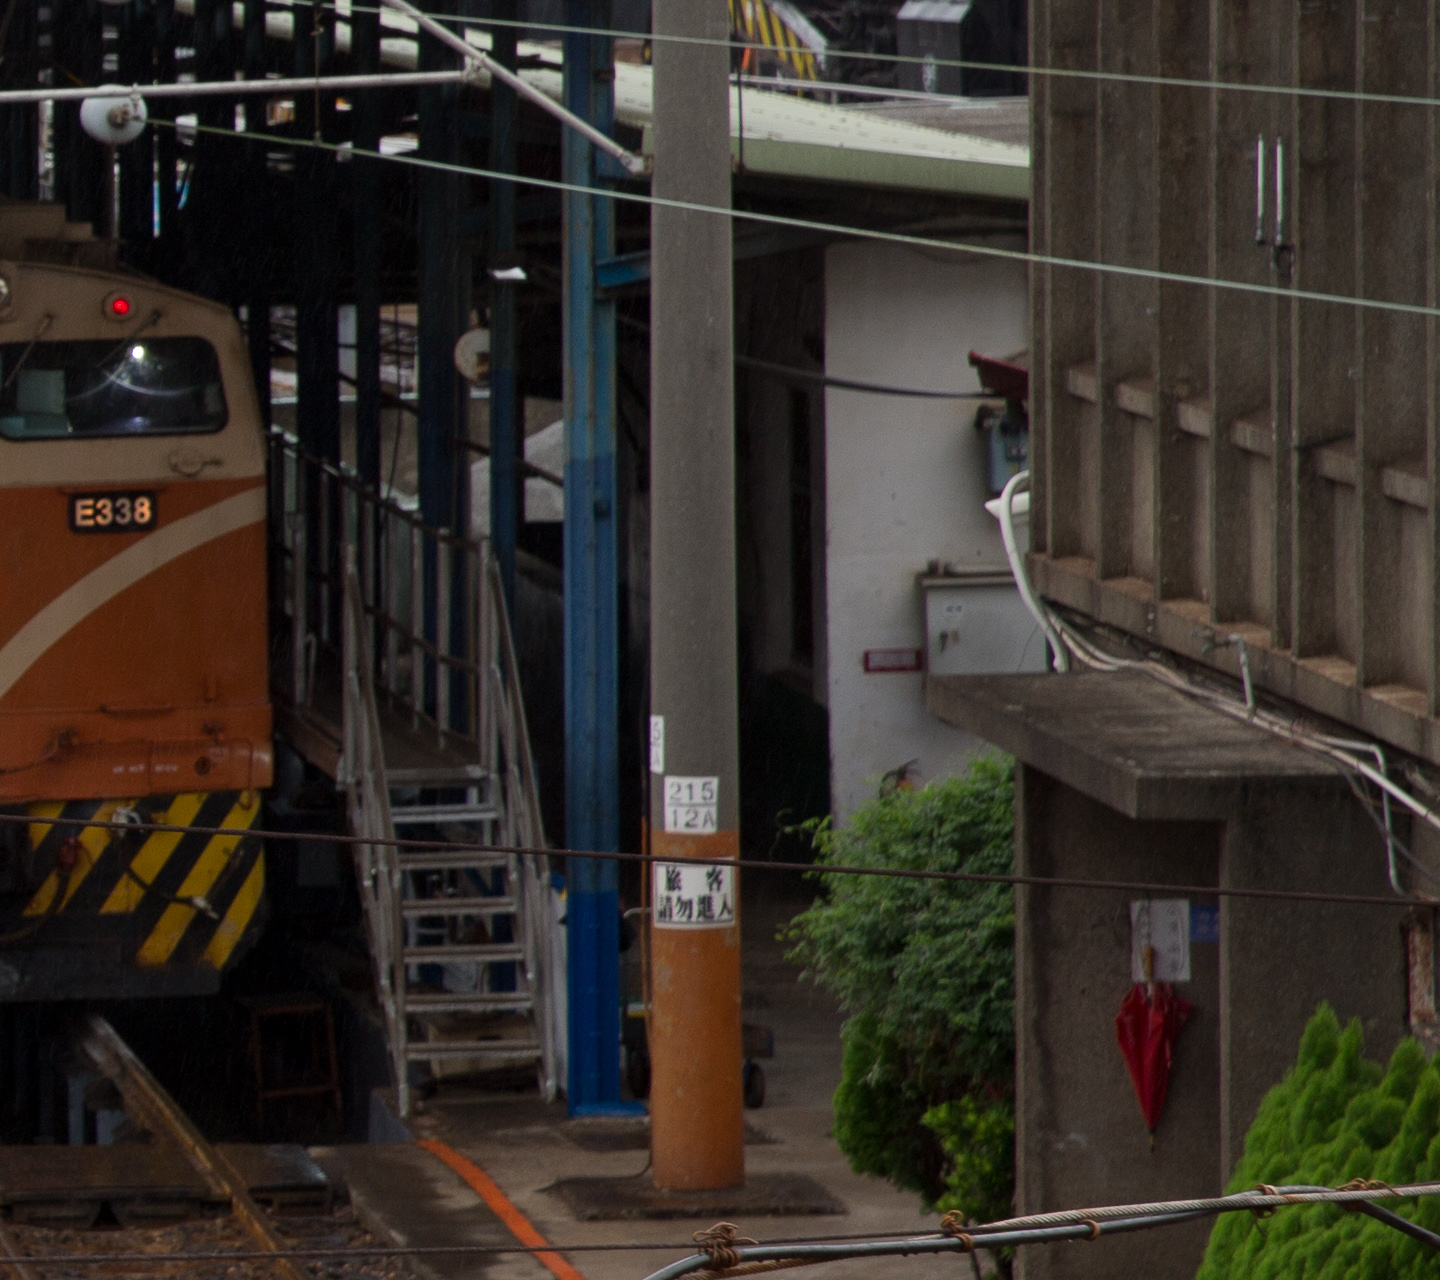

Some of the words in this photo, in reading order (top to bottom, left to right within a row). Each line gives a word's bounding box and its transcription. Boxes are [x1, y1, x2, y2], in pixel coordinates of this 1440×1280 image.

[75, 496, 152, 527] E338
[669, 781, 715, 802] 215
[670, 808, 715, 829] 12A
[657, 894, 733, 921] 請勿進入
